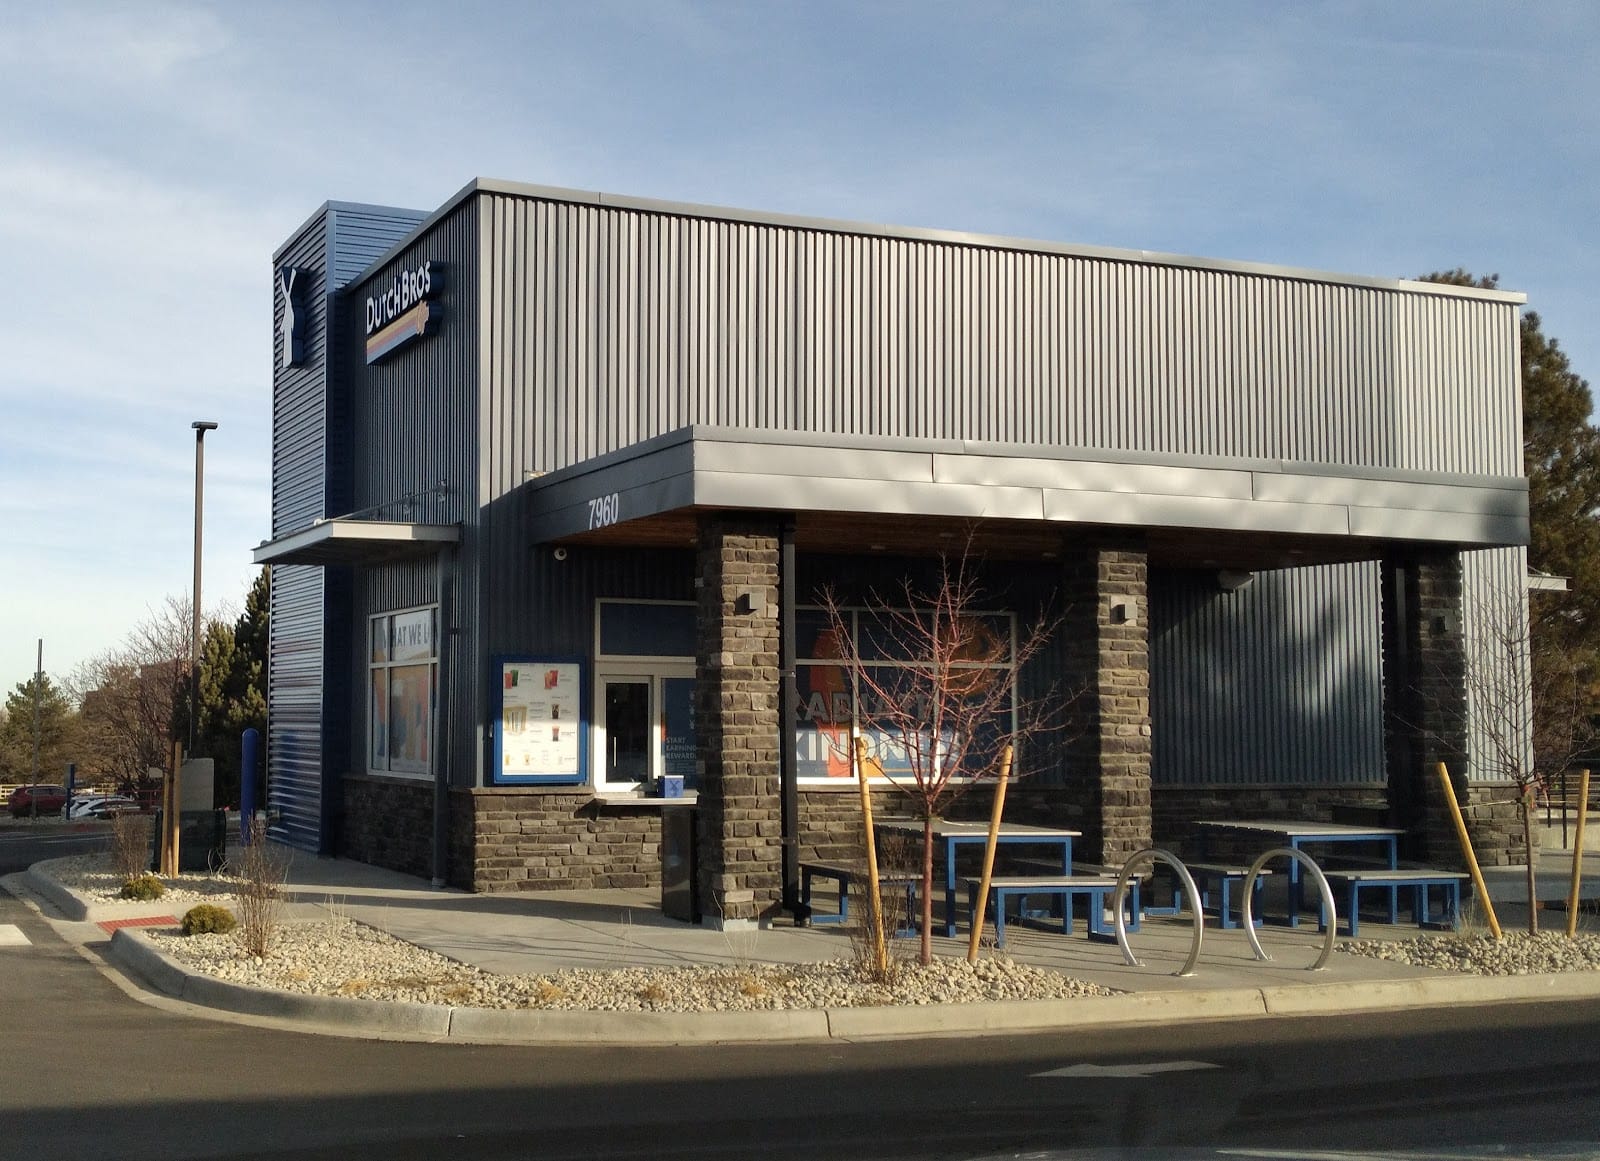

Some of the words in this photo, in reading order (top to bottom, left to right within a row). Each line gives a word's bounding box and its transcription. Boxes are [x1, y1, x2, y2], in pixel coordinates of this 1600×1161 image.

[366, 276, 401, 335] DUTCH
[401, 261, 431, 311] BROS
[588, 492, 619, 531] 7960
[666, 736, 686, 744] START
[666, 752, 697, 760] REWARD
